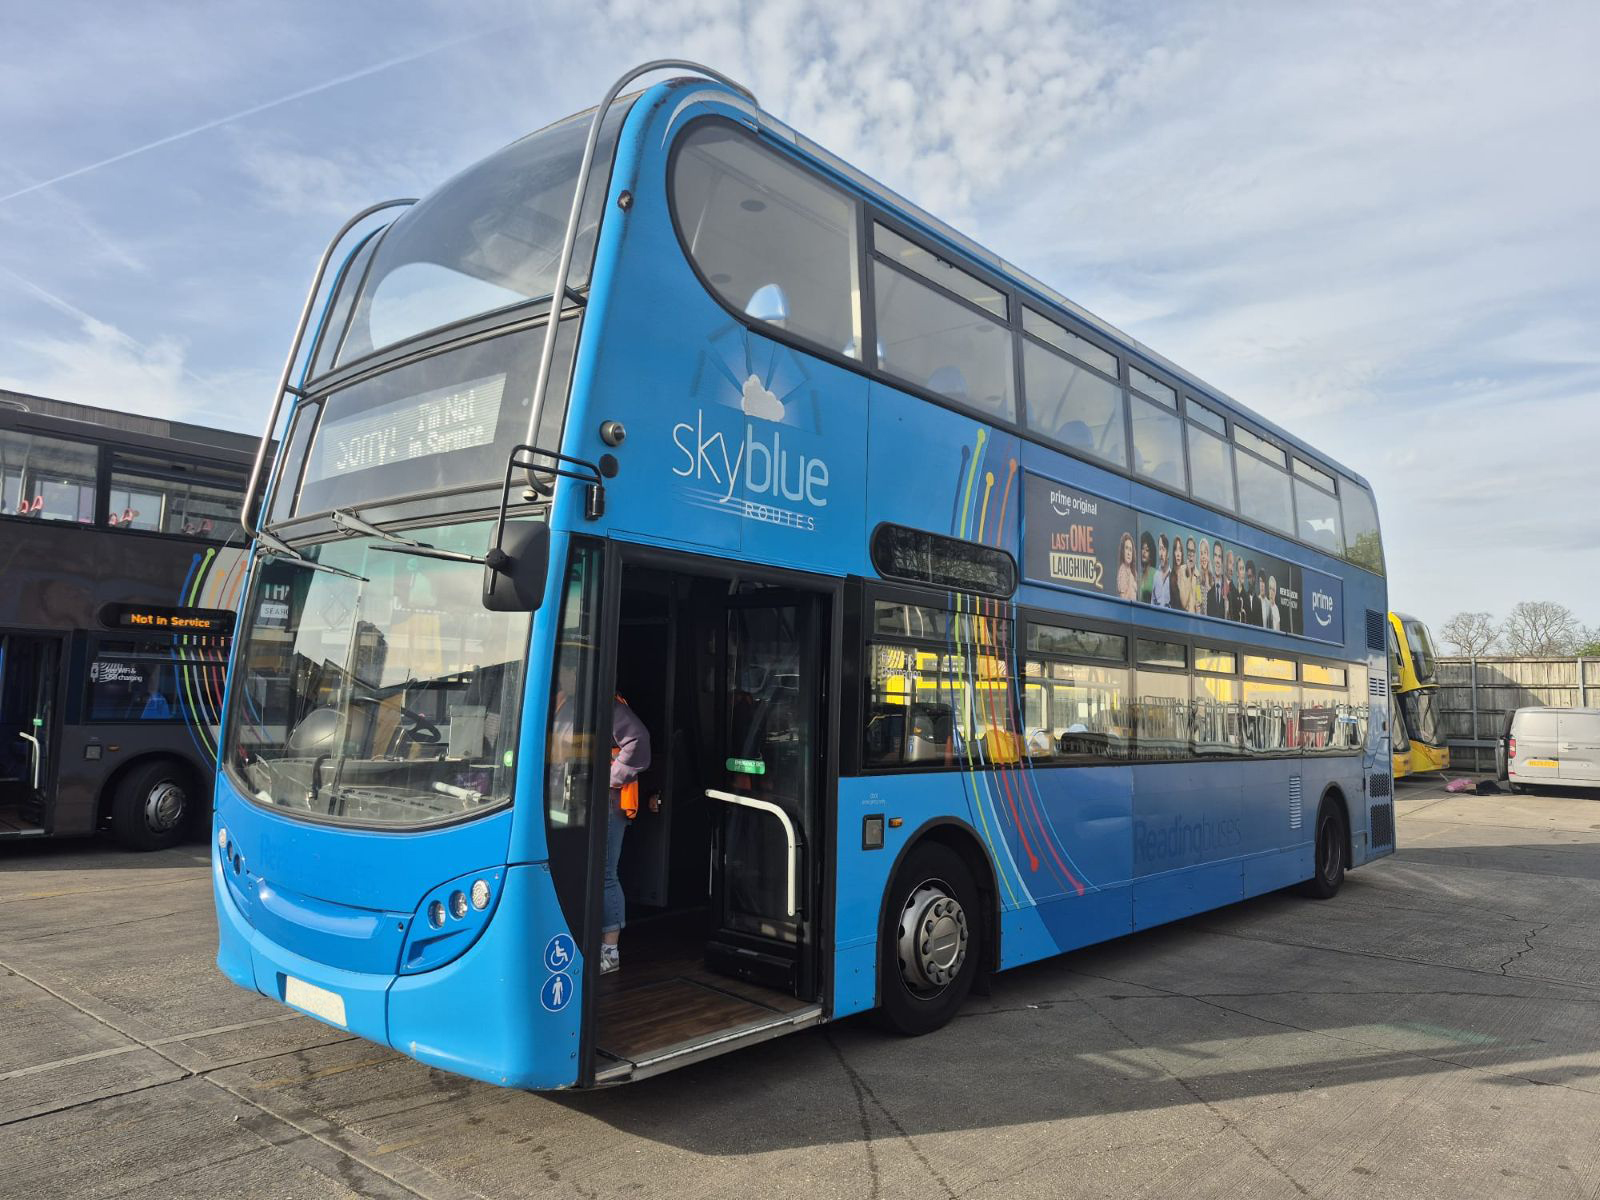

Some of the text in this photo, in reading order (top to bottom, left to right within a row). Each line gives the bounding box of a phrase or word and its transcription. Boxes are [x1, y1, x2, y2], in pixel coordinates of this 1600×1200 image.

[445, 389, 475, 425] Not
[427, 423, 484, 453] Service
[744, 503, 816, 531] ROUTES
[1050, 490, 1097, 516] prime original
[1051, 524, 1095, 554] LAST ONE
[1052, 555, 1104, 589] LAUGHING 2
[1312, 588, 1333, 612] prime
[131, 613, 210, 628] Not in Service
